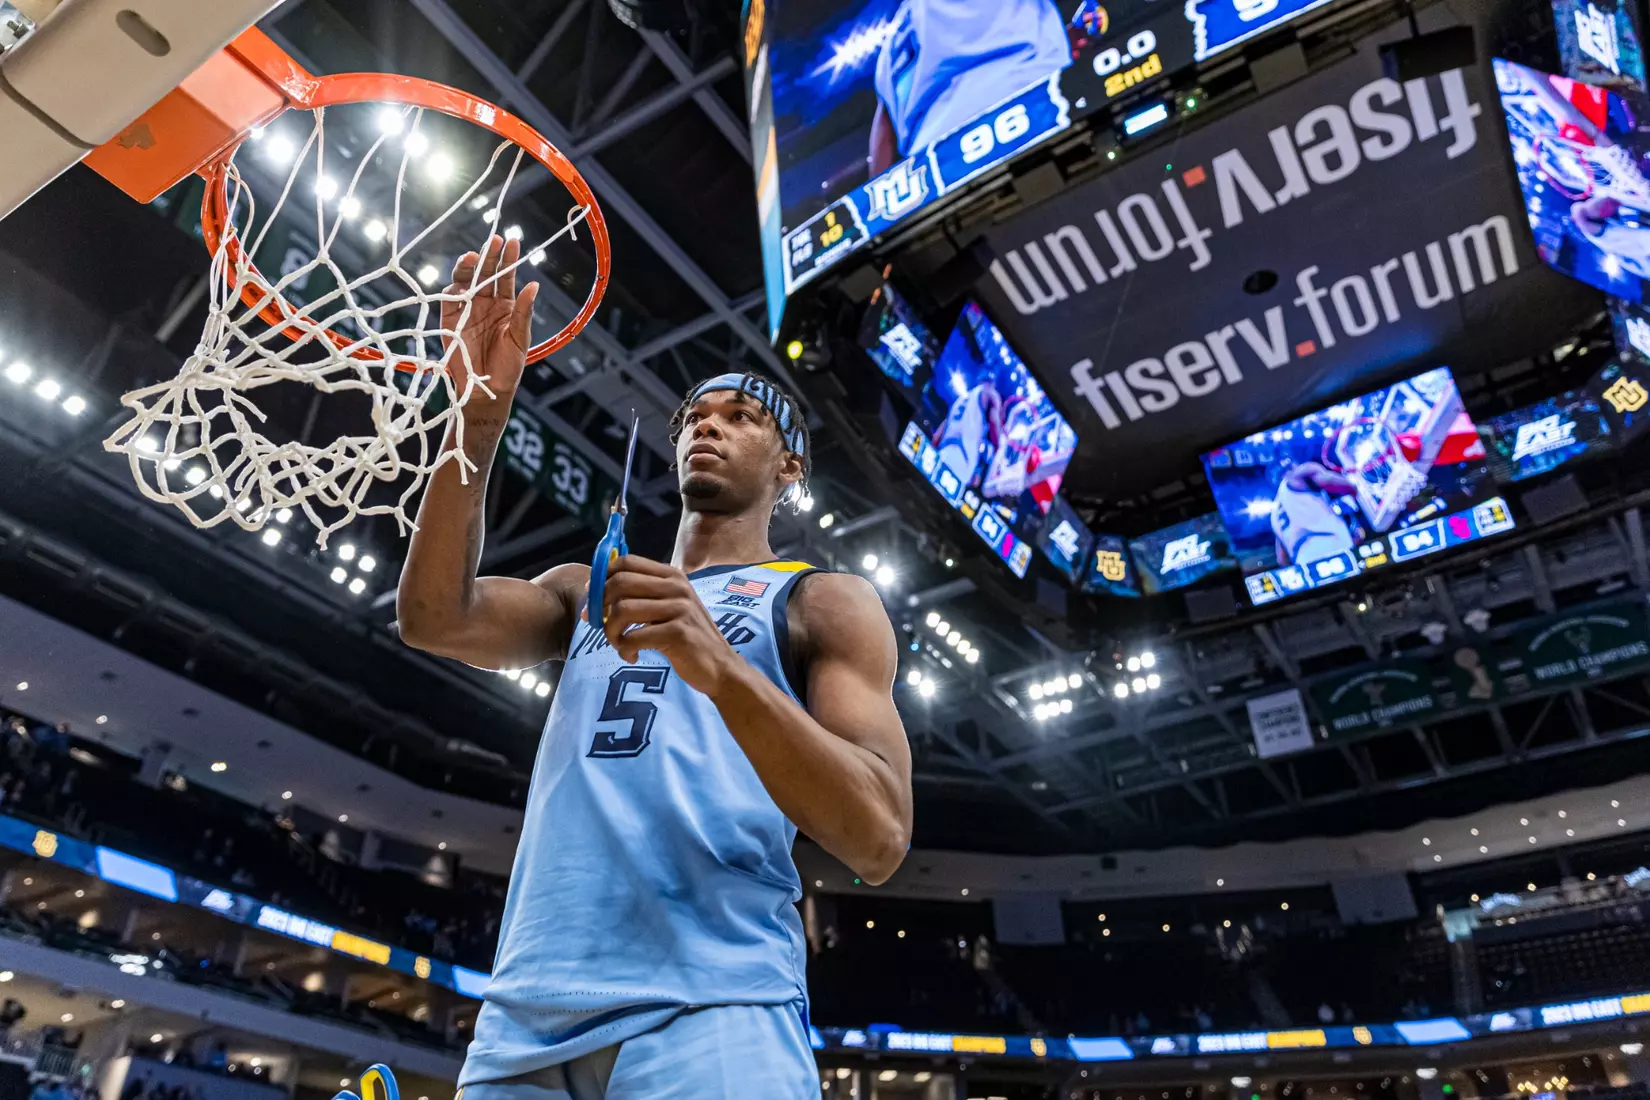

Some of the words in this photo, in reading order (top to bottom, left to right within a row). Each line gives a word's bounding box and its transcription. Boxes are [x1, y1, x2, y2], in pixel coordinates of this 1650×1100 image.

[1093, 29, 1157, 76] 0.0
[1104, 54, 1162, 97] 2nd
[959, 104, 1029, 164] 96
[864, 157, 929, 220] MU
[820, 223, 843, 247] 10
[504, 417, 545, 472] 32
[552, 455, 589, 505] 33
[715, 600, 760, 610] EAST
[727, 594, 756, 603] BIG
[586, 666, 670, 758] 5
